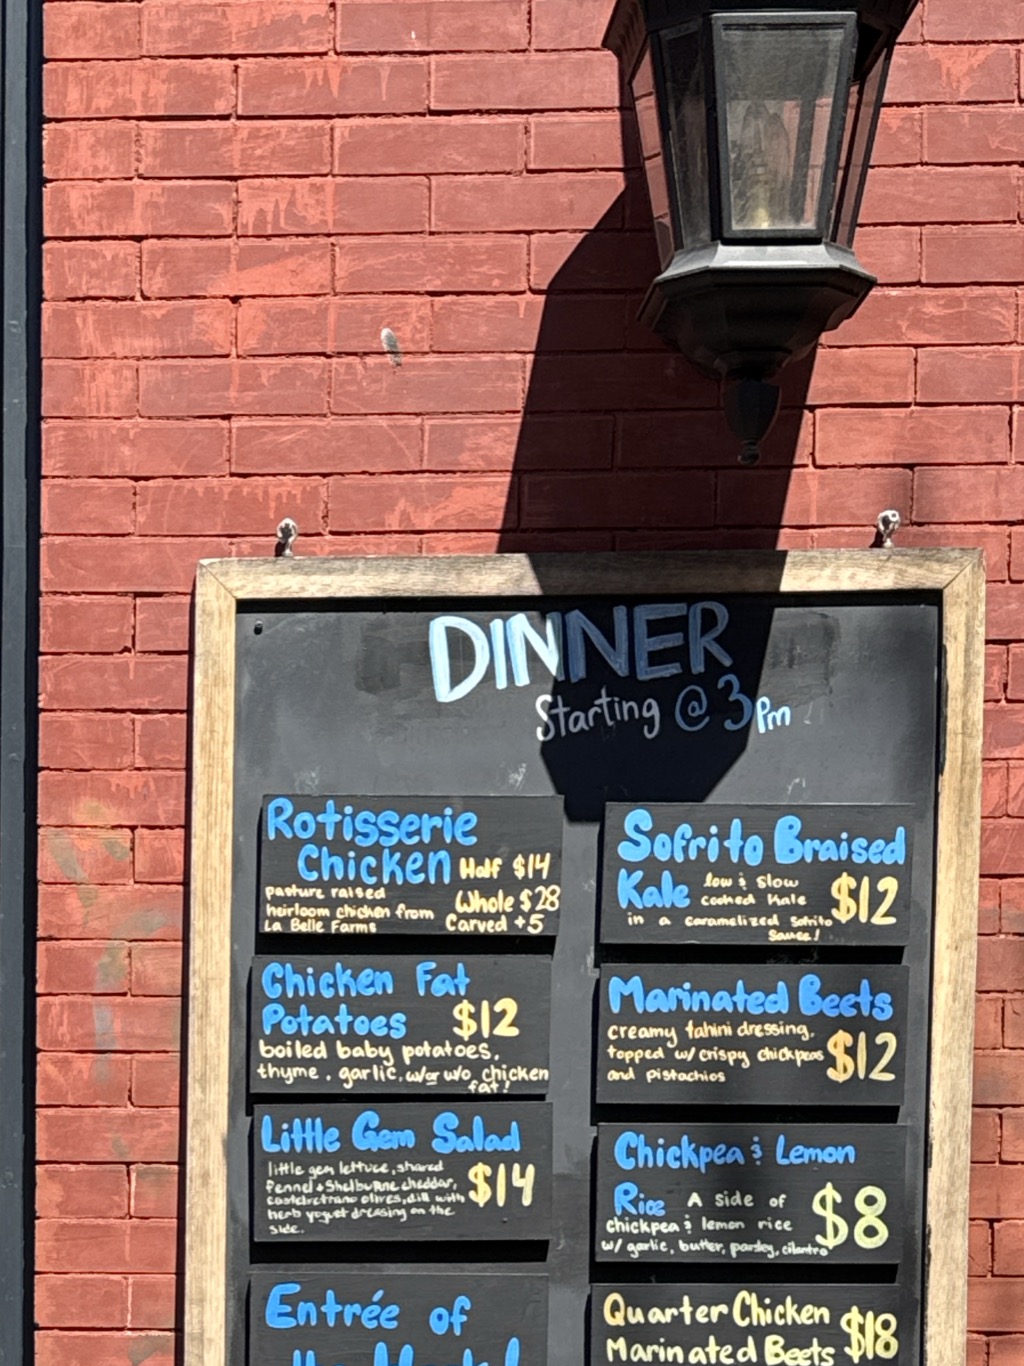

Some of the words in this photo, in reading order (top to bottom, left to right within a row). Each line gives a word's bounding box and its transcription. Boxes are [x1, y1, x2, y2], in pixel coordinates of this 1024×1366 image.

[429, 601, 734, 702] DINNER
[535, 684, 660, 741] Starting
[675, 685, 710, 731] @
[267, 797, 478, 846] Rotisserie
[617, 808, 763, 866] Sofrito
[774, 815, 905, 865] Braised
[297, 843, 451, 886] Chicken
[459, 857, 503, 879] Half
[513, 853, 551, 880] $14
[265, 884, 325, 900] pasture
[331, 886, 386, 899] raised
[617, 868, 691, 909] Kale
[703, 872, 733, 888] low
[266, 903, 330, 917] heirloom
[336, 904, 391, 919] chicken
[395, 903, 434, 919] from
[455, 889, 514, 913] Whole
[700, 893, 755, 906] cooked
[830, 871, 898, 925] $12
[264, 919, 282, 932] La
[290, 917, 325, 932] Belle
[331, 920, 377, 933] Farms
[446, 914, 507, 933] Carved
[627, 912, 644, 925] in
[659, 916, 671, 925] a
[685, 914, 779, 926] caramelized
[262, 961, 393, 999] Chicken
[416, 961, 470, 997] Fat
[608, 975, 789, 1014] Marinated
[798, 974, 894, 1021] Beets
[262, 1002, 407, 1039] Potatoes
[453, 997, 520, 1041] $12
[607, 1024, 677, 1047] creamy
[685, 1019, 732, 1038] tahini
[259, 1039, 327, 1059] boiled
[336, 1040, 394, 1066] baby
[607, 1045, 665, 1063] topped
[675, 1046, 695, 1060] w/
[699, 1047, 750, 1068] crispy
[757, 1047, 825, 1067] chickpeas
[826, 1029, 897, 1084] $12
[482, 1064, 549, 1083] chicken
[607, 1067, 635, 1081] and
[646, 1069, 726, 1083] pistachios
[261, 1115, 341, 1153] Little
[352, 1110, 416, 1151] Gem
[432, 1111, 520, 1154] Salad
[614, 1130, 745, 1173] Chickpea
[776, 1134, 856, 1165] Lemon
[268, 1161, 304, 1177] little
[435, 1194, 465, 1203] with
[468, 1162, 535, 1208] $14
[614, 1181, 666, 1217] Rice
[687, 1191, 703, 1207] A
[715, 1190, 754, 1206] side
[769, 1194, 787, 1208] of
[268, 1208, 301, 1220] herb
[351, 1206, 407, 1222] dressing
[410, 1208, 425, 1216] on
[429, 1205, 456, 1216] the
[606, 1217, 679, 1236] chickpea
[702, 1216, 745, 1231] lemon
[758, 1217, 793, 1231] rice
[812, 1181, 889, 1249] $8
[601, 1238, 622, 1253] w/
[265, 1282, 400, 1330] Entrée
[429, 1295, 471, 1336] of
[603, 1292, 729, 1327] Quarter
[733, 1290, 830, 1327] Chicken
[840, 1305, 898, 1364] $18
[606, 1335, 757, 1365] Marinated
[764, 1334, 835, 1366] Beets
